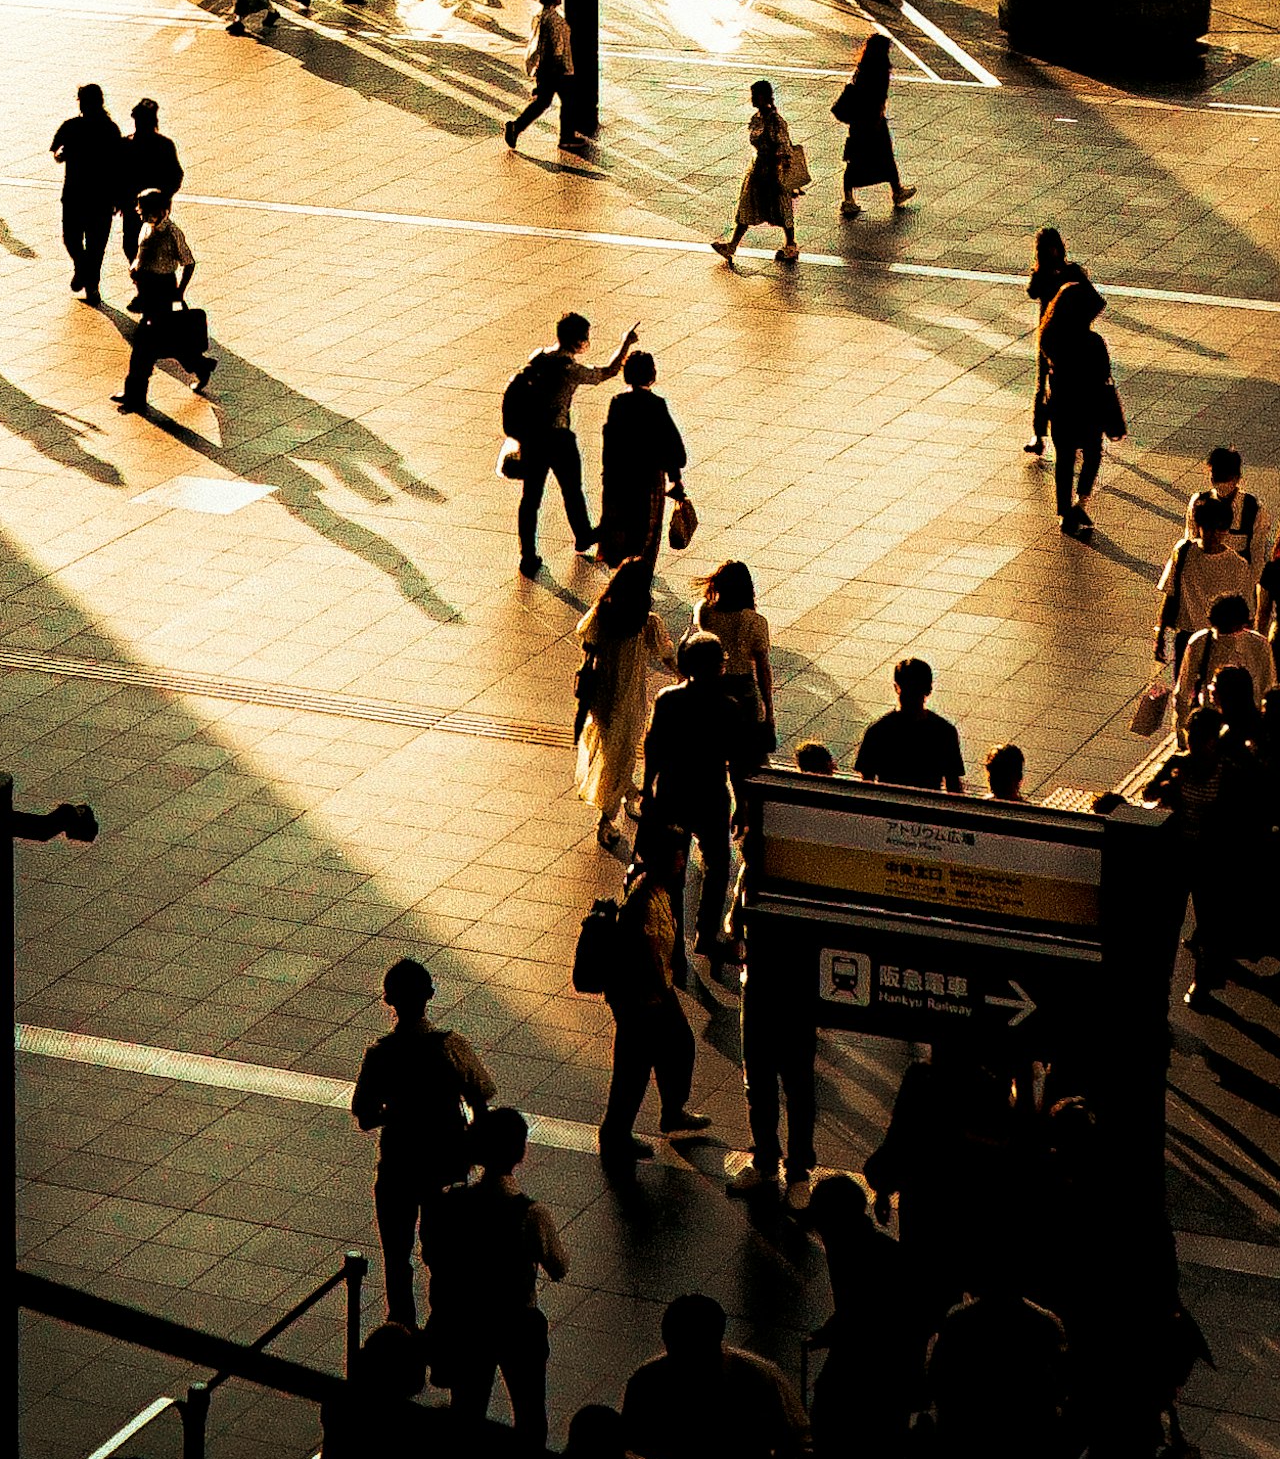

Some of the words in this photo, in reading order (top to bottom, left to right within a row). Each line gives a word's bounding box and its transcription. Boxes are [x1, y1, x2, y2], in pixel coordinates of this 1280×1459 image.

[886, 821, 975, 846] アトリウム広場
[886, 862, 943, 881] 中央北口
[879, 965, 969, 998] 阪急電車
[878, 990, 923, 1008] Hankyu
[927, 997, 973, 1018] Railway
